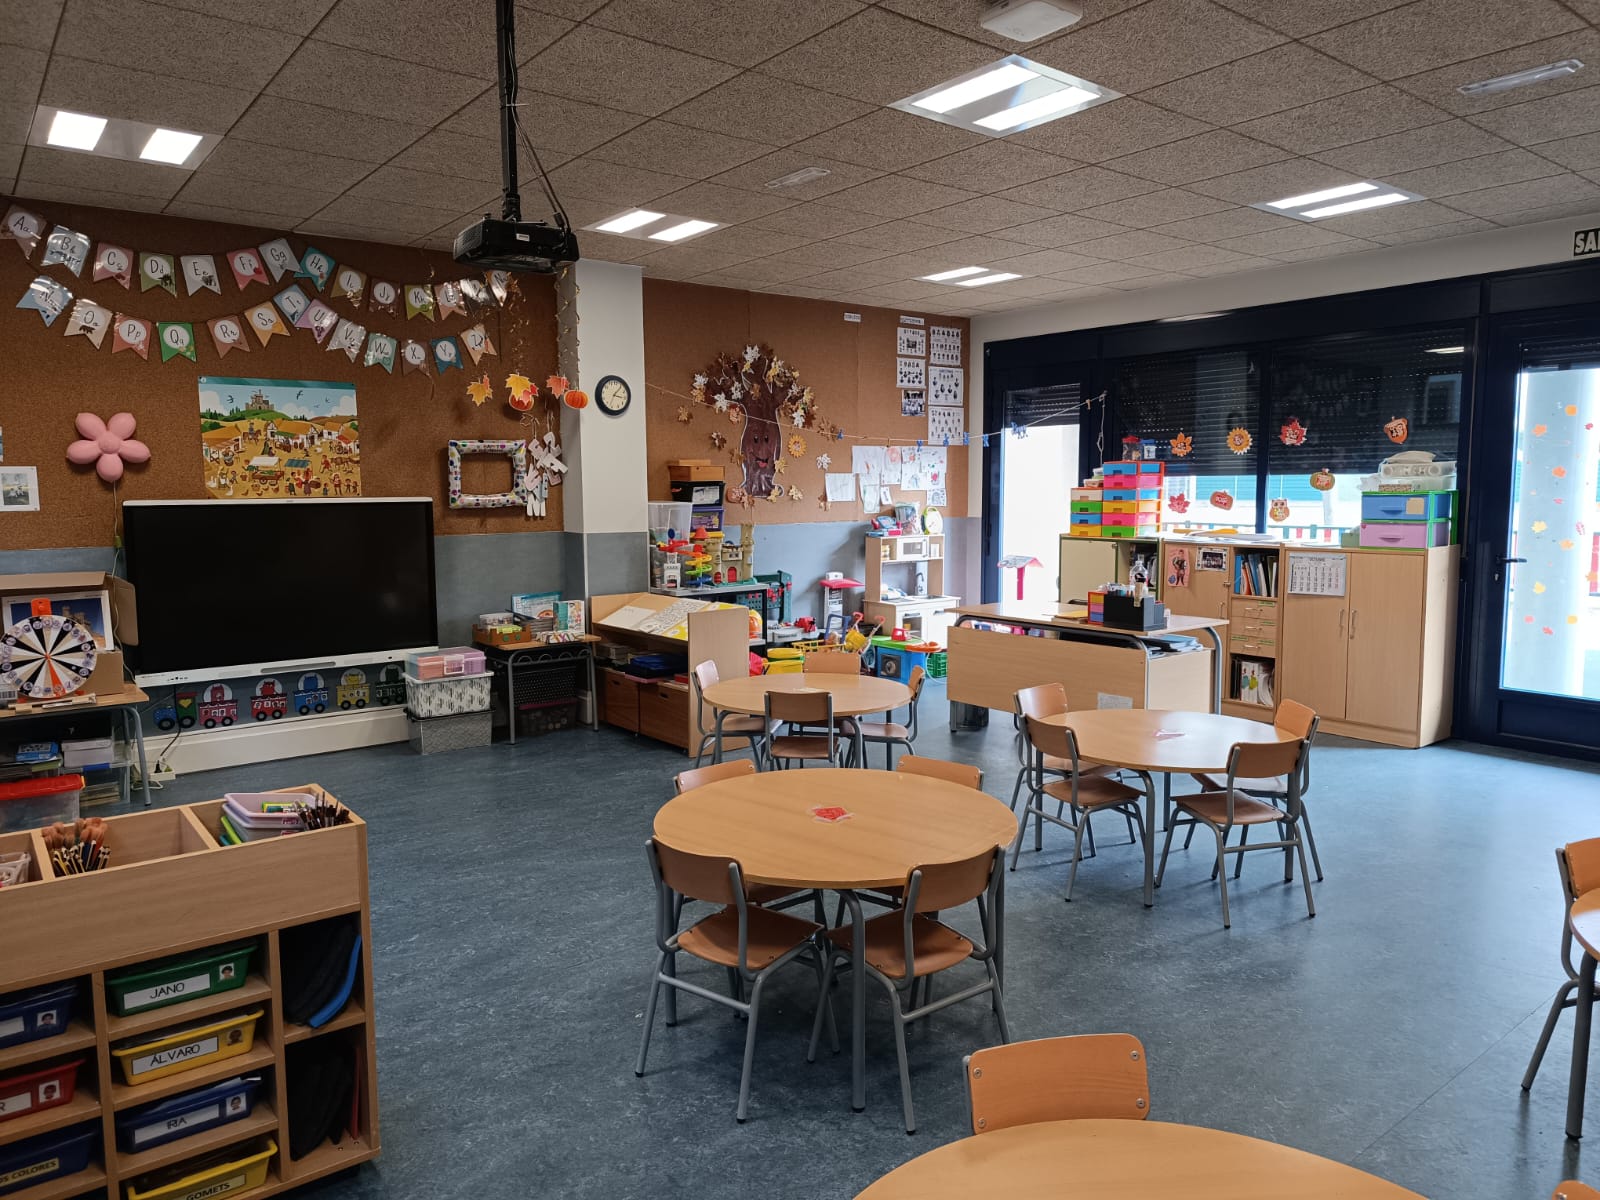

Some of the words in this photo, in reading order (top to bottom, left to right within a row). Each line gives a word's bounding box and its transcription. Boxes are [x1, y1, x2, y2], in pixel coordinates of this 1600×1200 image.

[1575, 231, 1600, 253] SA
[150, 982, 185, 999] JANO
[12, 1161, 57, 1179] COLORES
[186, 1183, 231, 1200] GOMETS
